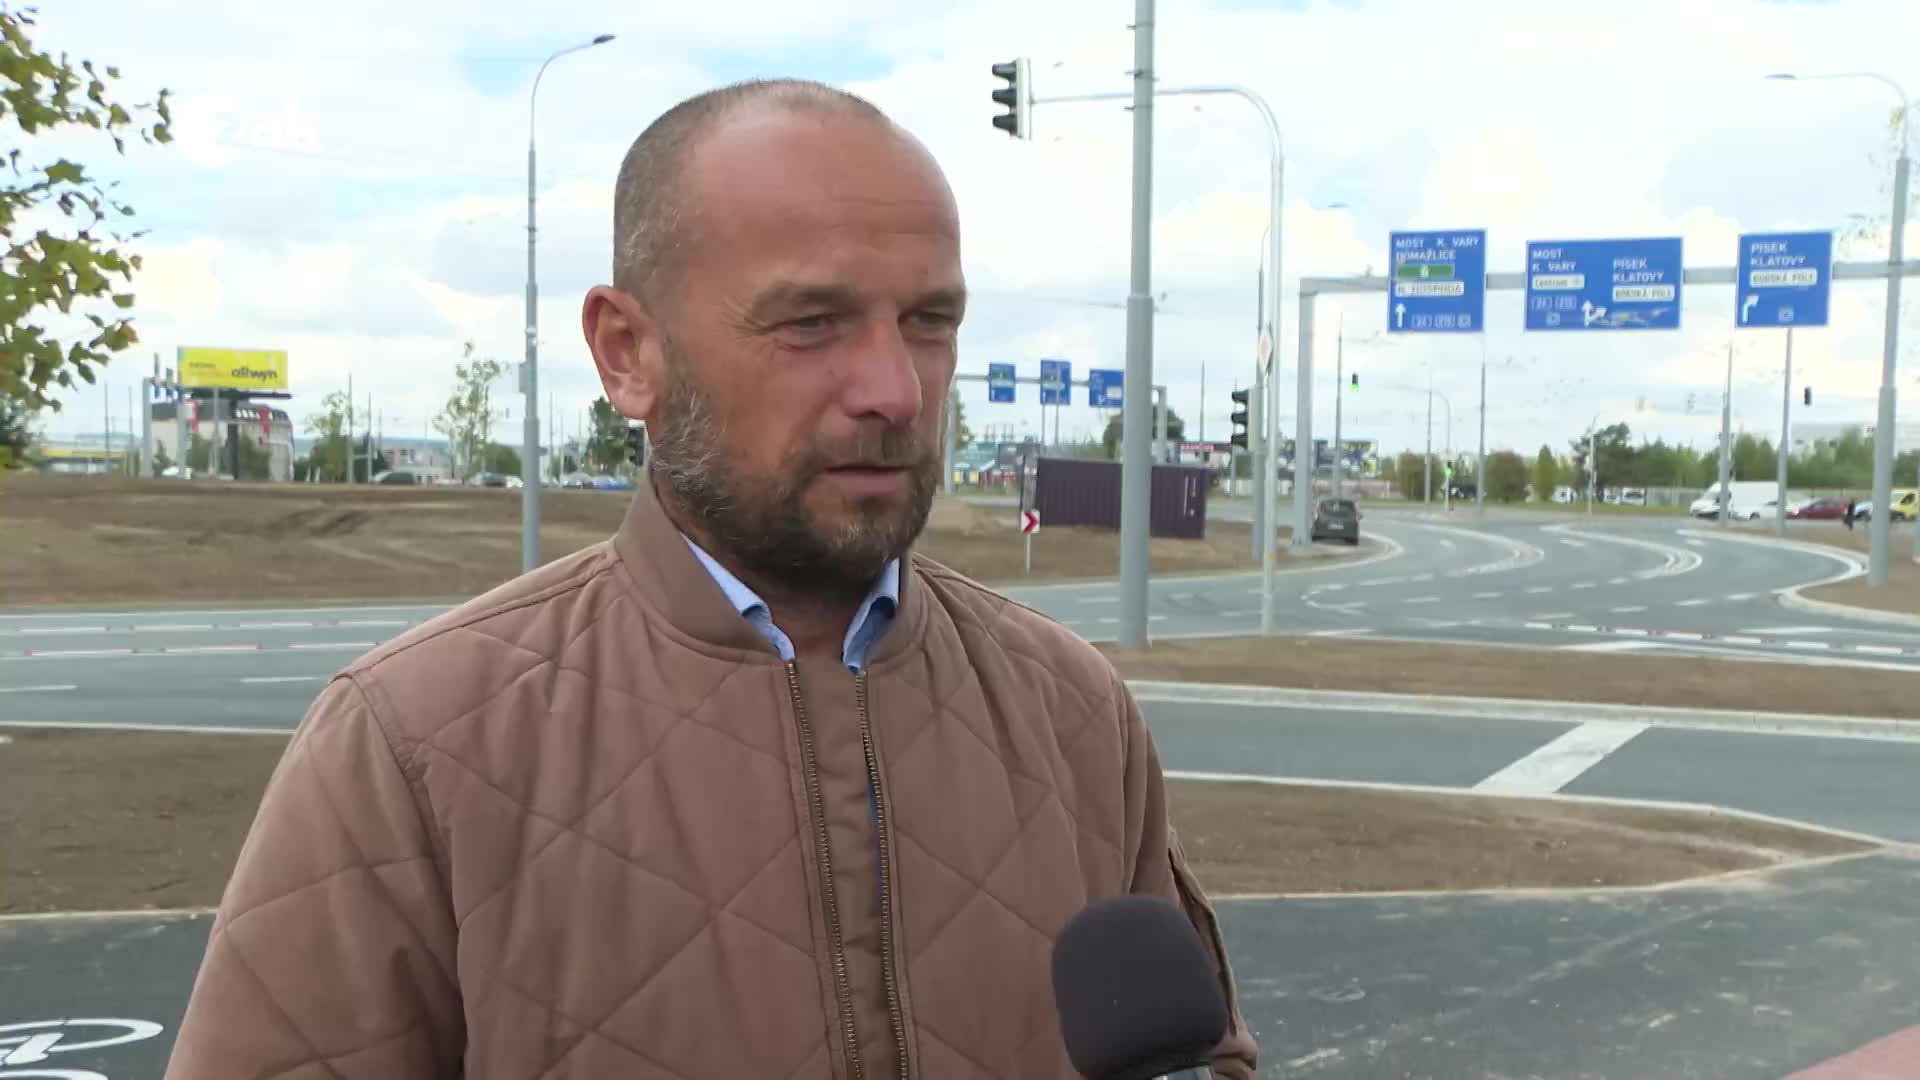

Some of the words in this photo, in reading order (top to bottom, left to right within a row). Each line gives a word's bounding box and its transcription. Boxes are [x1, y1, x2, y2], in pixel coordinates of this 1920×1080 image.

[1396, 237, 1424, 248] MOST
[1452, 236, 1479, 247] VARY
[1533, 249, 1562, 259] MOST
[1750, 255, 1805, 266] KLATOVY
[1548, 262, 1576, 272] VARY
[1612, 272, 1664, 283] KLATOVY
[231, 365, 278, 383] allwyn
